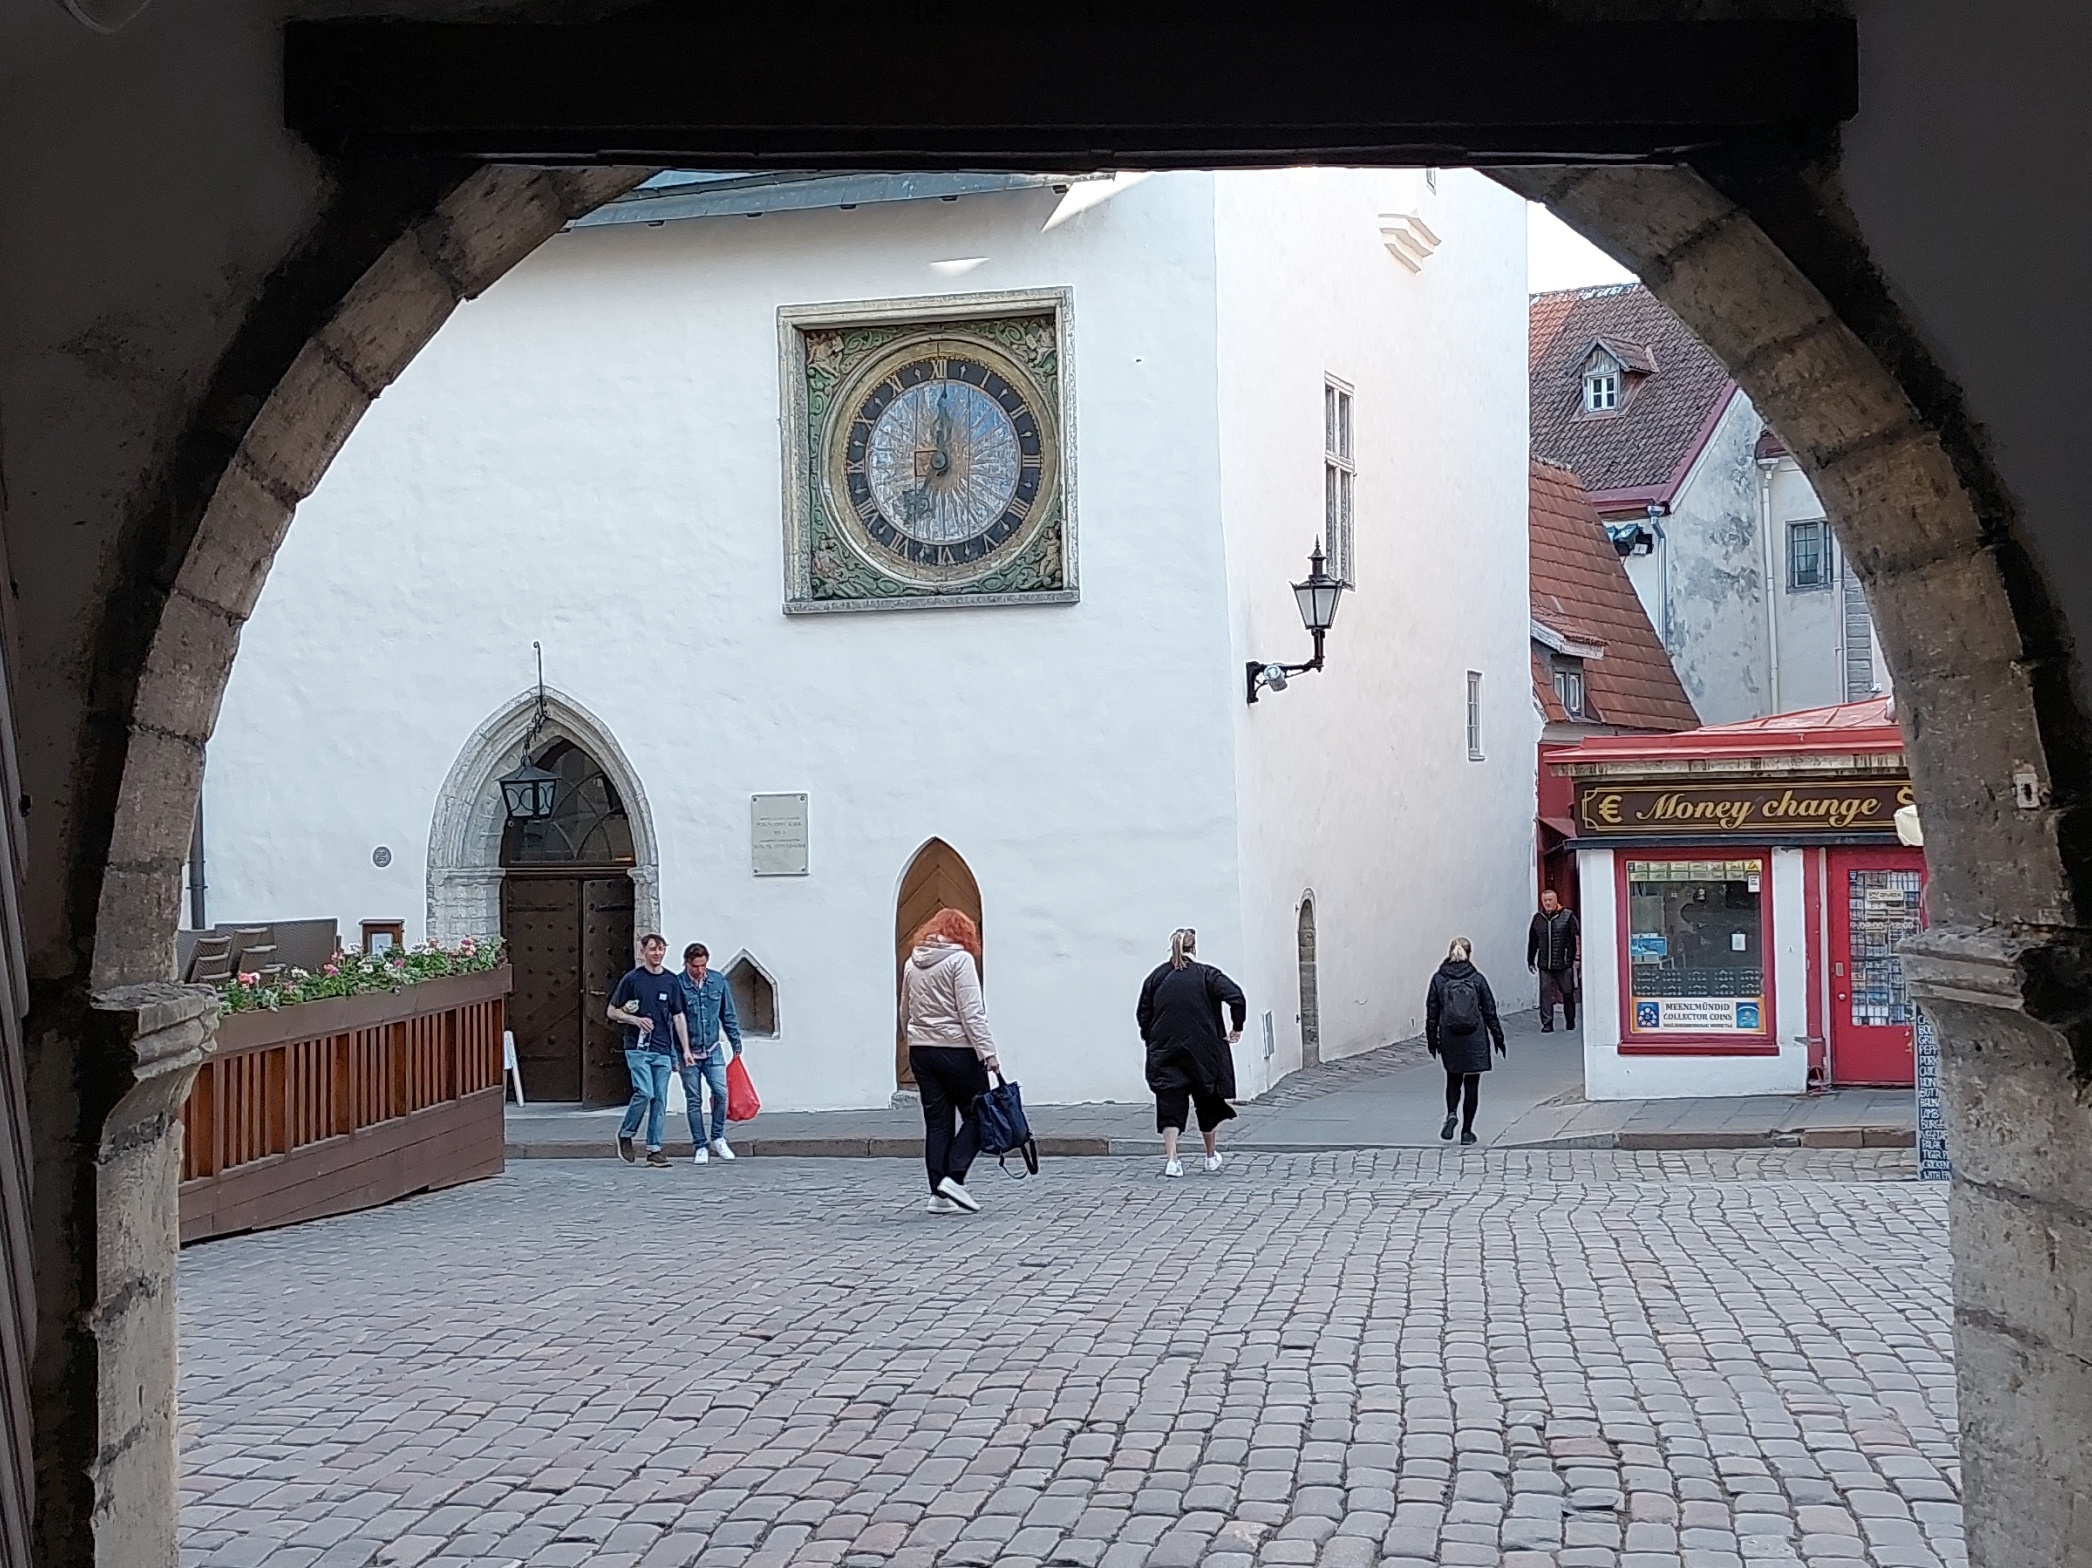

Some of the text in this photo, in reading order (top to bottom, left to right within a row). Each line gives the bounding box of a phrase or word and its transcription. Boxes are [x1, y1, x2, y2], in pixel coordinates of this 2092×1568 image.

[930, 359, 948, 379] XII
[886, 375, 905, 395] XI
[980, 371, 991, 388] I
[855, 409, 875, 430] X
[1009, 404, 1028, 419] II
[847, 460, 865, 474] IX
[1023, 454, 1041, 468] III
[857, 497, 880, 525] VIII
[1008, 497, 1030, 516] IIII
[889, 534, 909, 557] VII
[982, 534, 998, 552] V
[937, 546, 955, 564] VI
[1598, 795, 1623, 823] €
[1636, 792, 1755, 830] Money
[1762, 790, 1881, 827] change
[1663, 1013, 1733, 1021] COLLECTOR COINS
